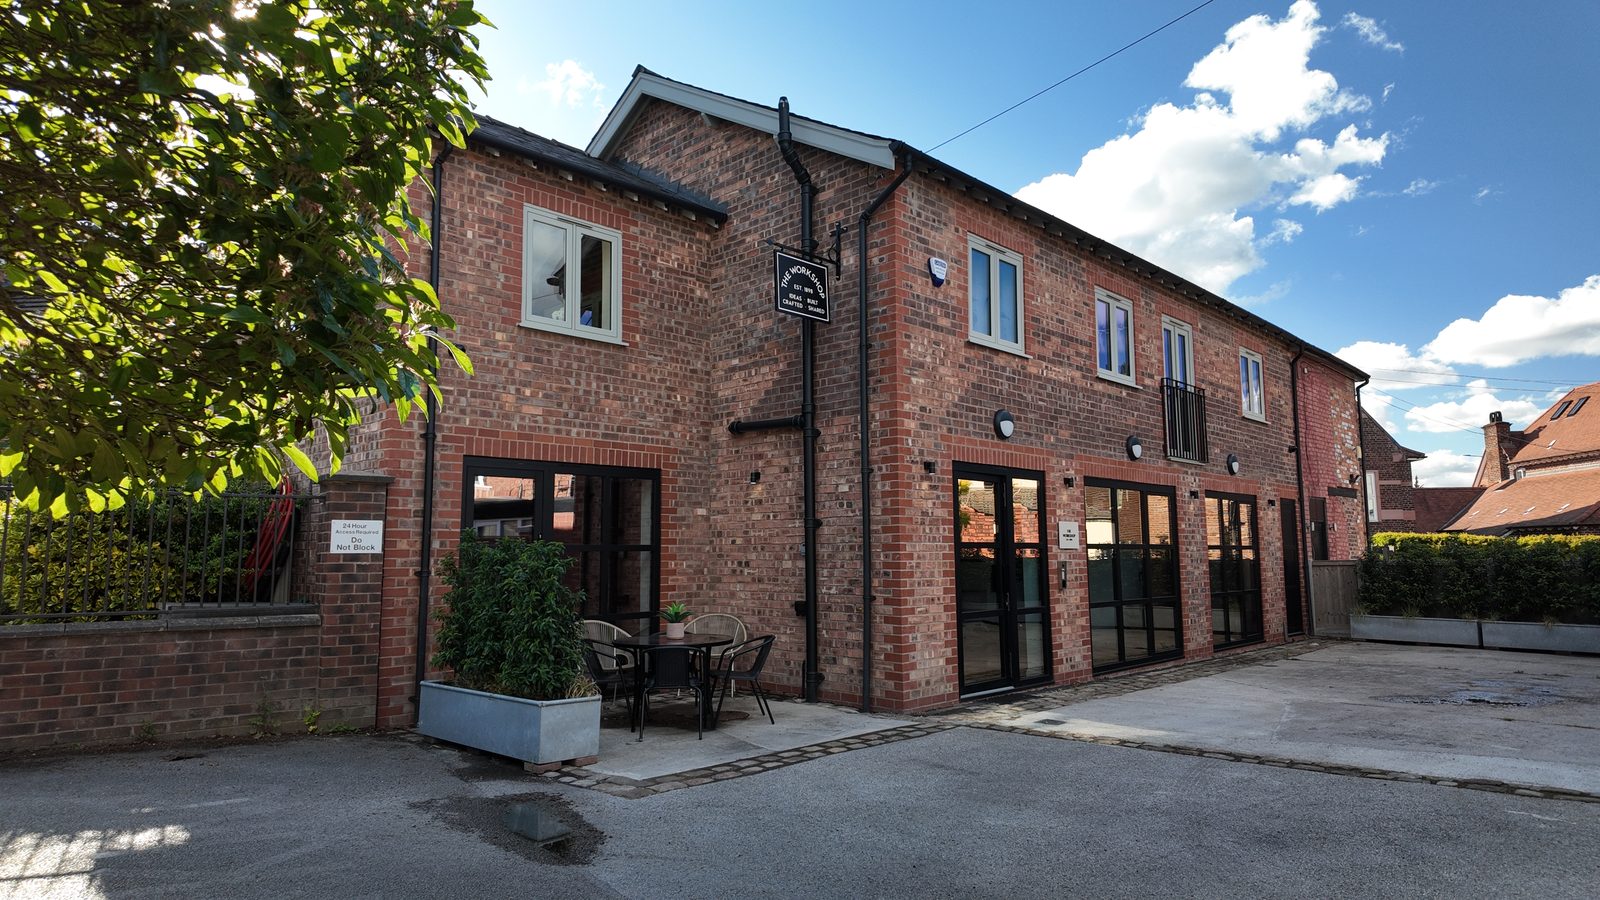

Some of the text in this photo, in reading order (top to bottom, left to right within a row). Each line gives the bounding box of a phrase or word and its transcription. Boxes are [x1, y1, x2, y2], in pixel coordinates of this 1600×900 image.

[781, 266, 826, 299] THE WORKSHOP
[782, 299, 825, 314] CRAFTED SHARED
